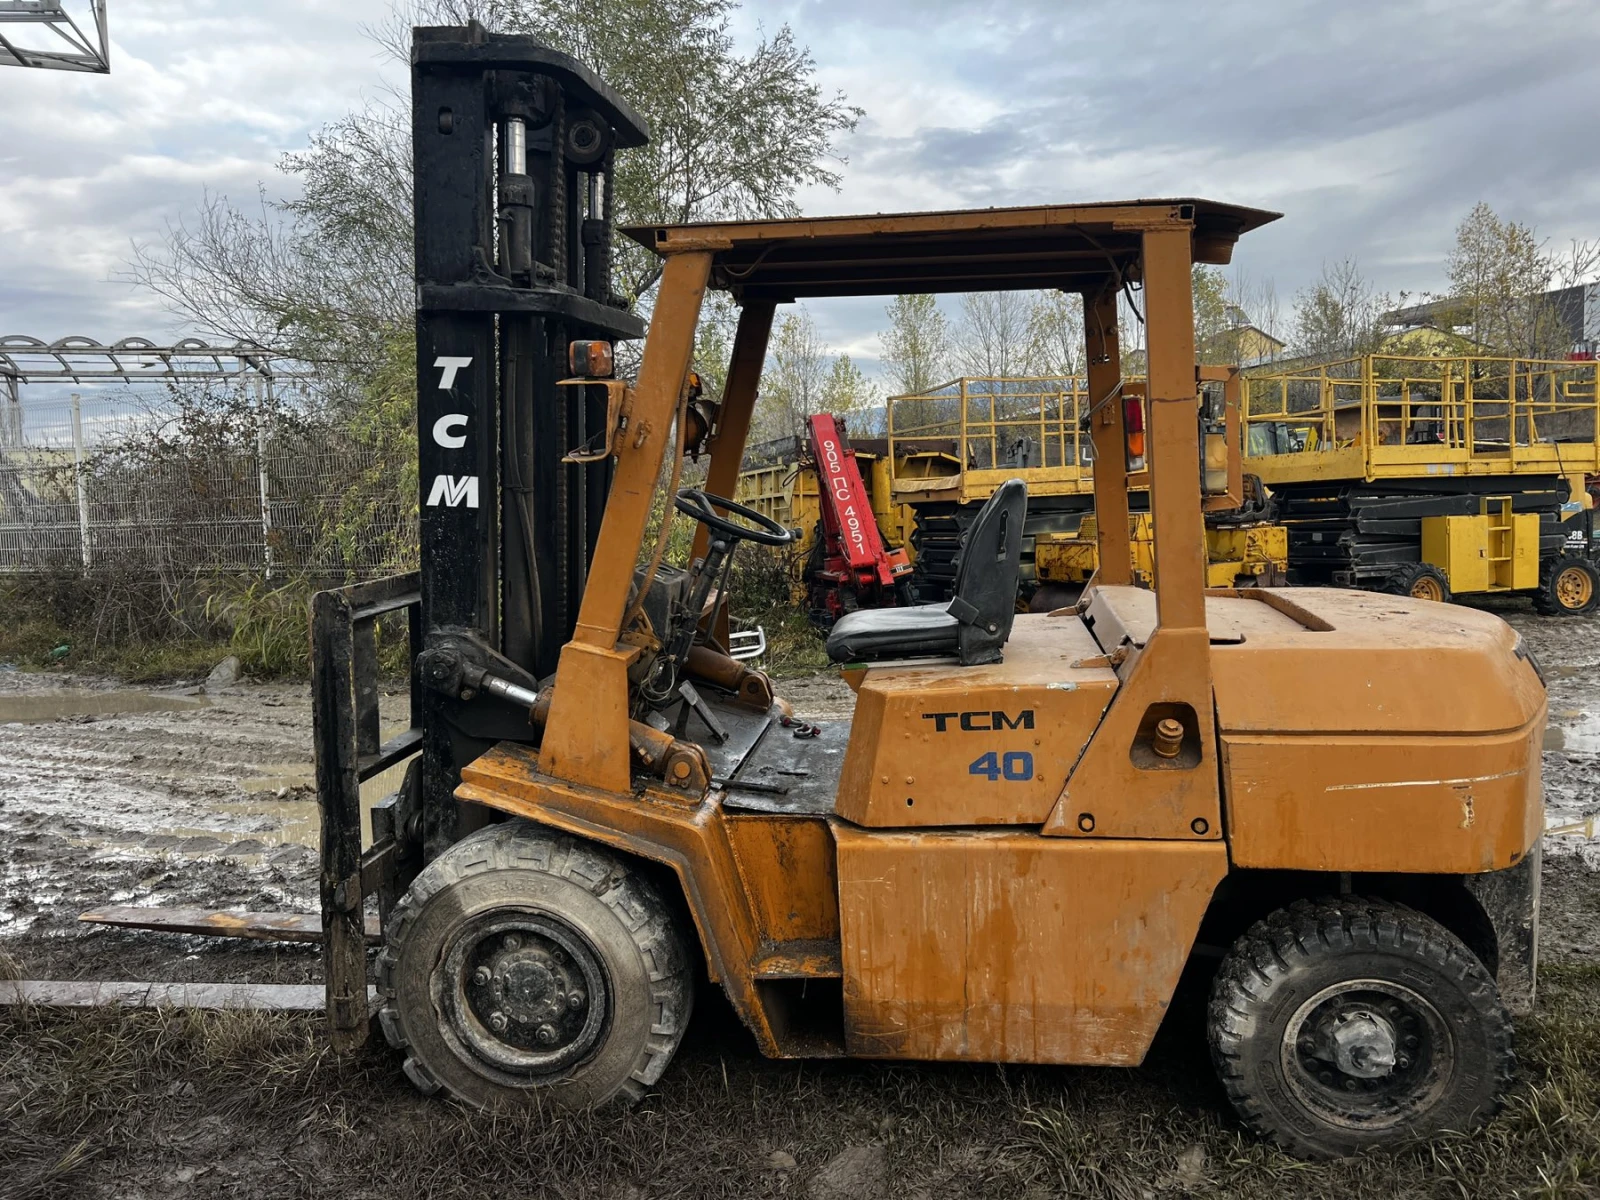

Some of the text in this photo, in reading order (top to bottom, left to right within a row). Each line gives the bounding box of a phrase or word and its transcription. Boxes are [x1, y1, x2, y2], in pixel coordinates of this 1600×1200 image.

[426, 356, 479, 509] TCM
[823, 440, 841, 474] 905
[844, 505, 864, 555] 4951
[922, 709, 1035, 732] TCM
[968, 751, 1034, 781] 40
